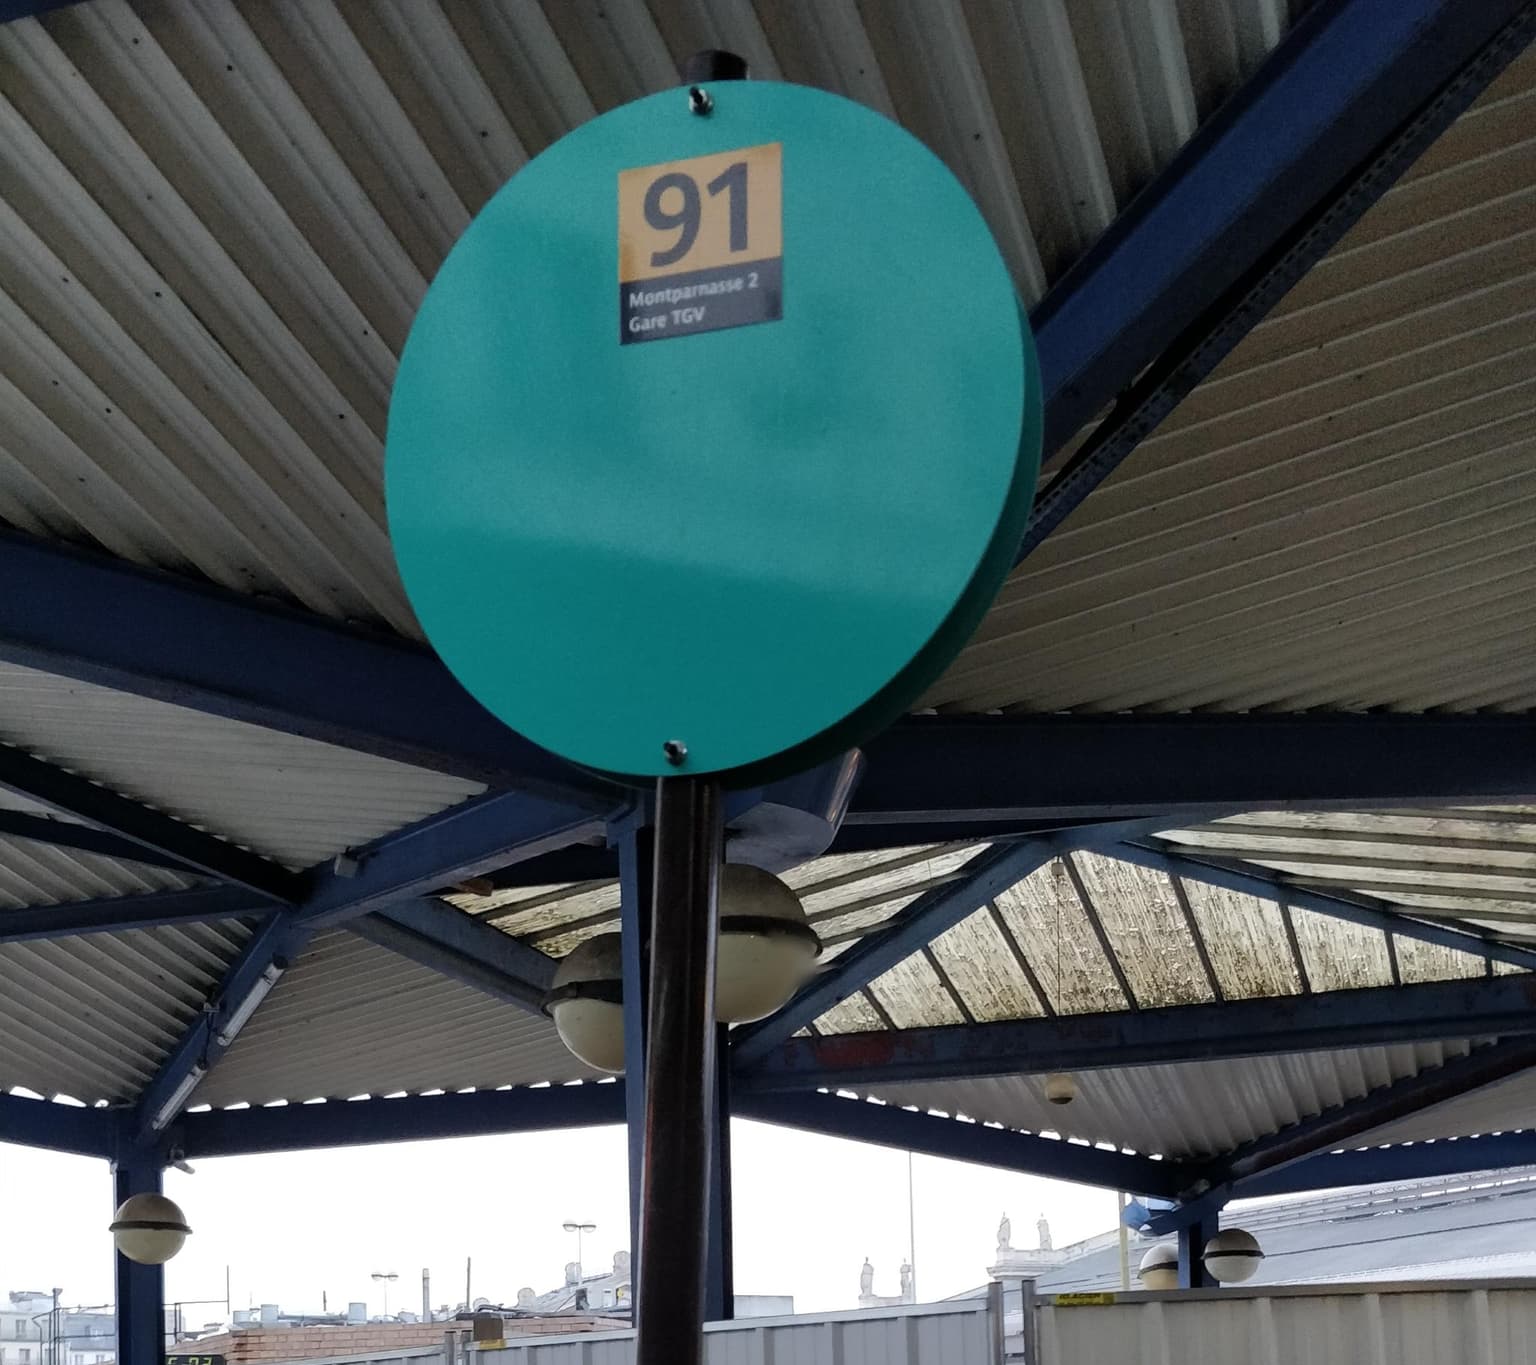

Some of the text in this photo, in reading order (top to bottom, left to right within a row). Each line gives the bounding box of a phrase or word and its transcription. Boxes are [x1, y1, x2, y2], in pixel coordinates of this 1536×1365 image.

[643, 162, 748, 268] 91
[629, 272, 759, 308] Montparnasse 2
[628, 306, 706, 333] Gare TGV
